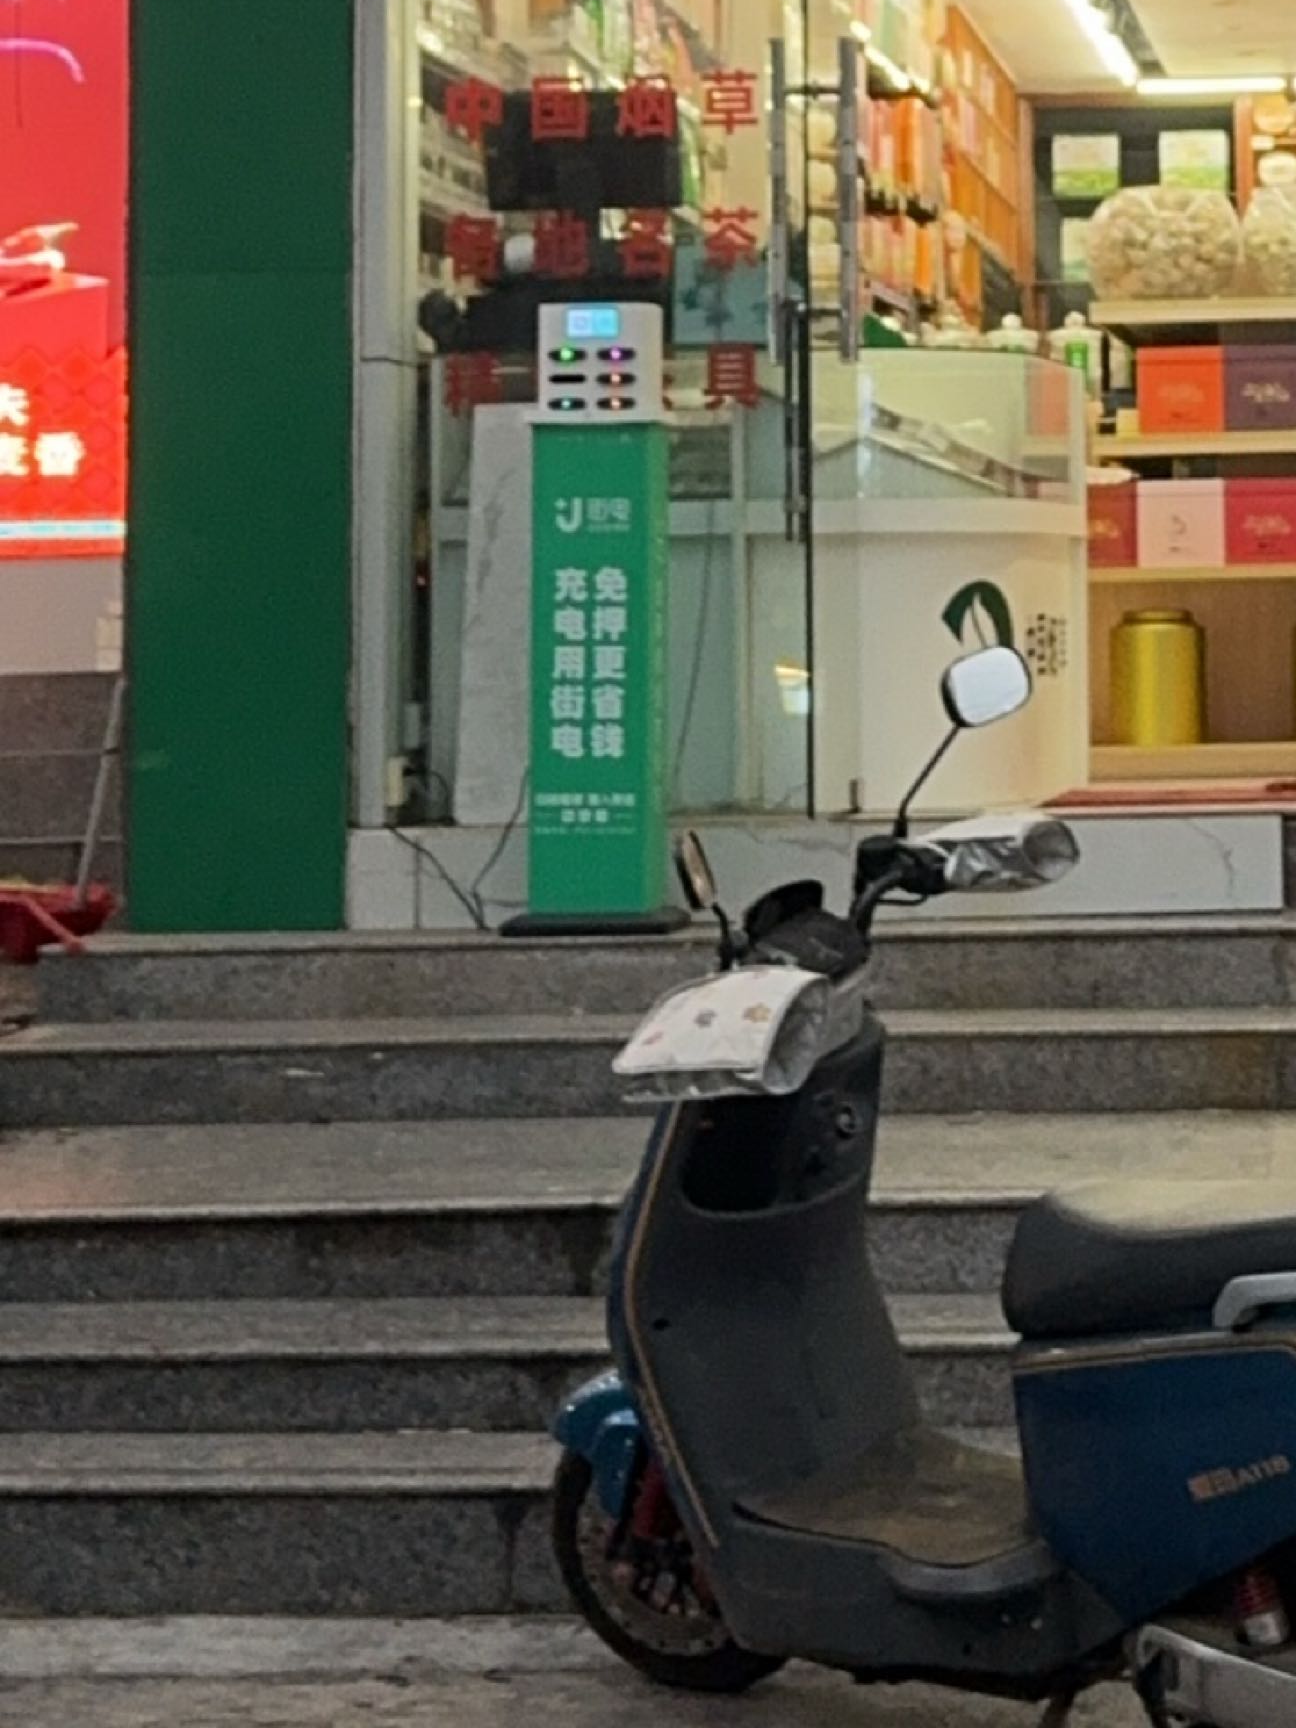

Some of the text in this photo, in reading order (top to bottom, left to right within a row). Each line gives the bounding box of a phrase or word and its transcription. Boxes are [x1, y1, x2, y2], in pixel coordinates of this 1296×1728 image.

[550, 566, 588, 760] 充电用街电
[590, 565, 629, 760] 免押更省钱
